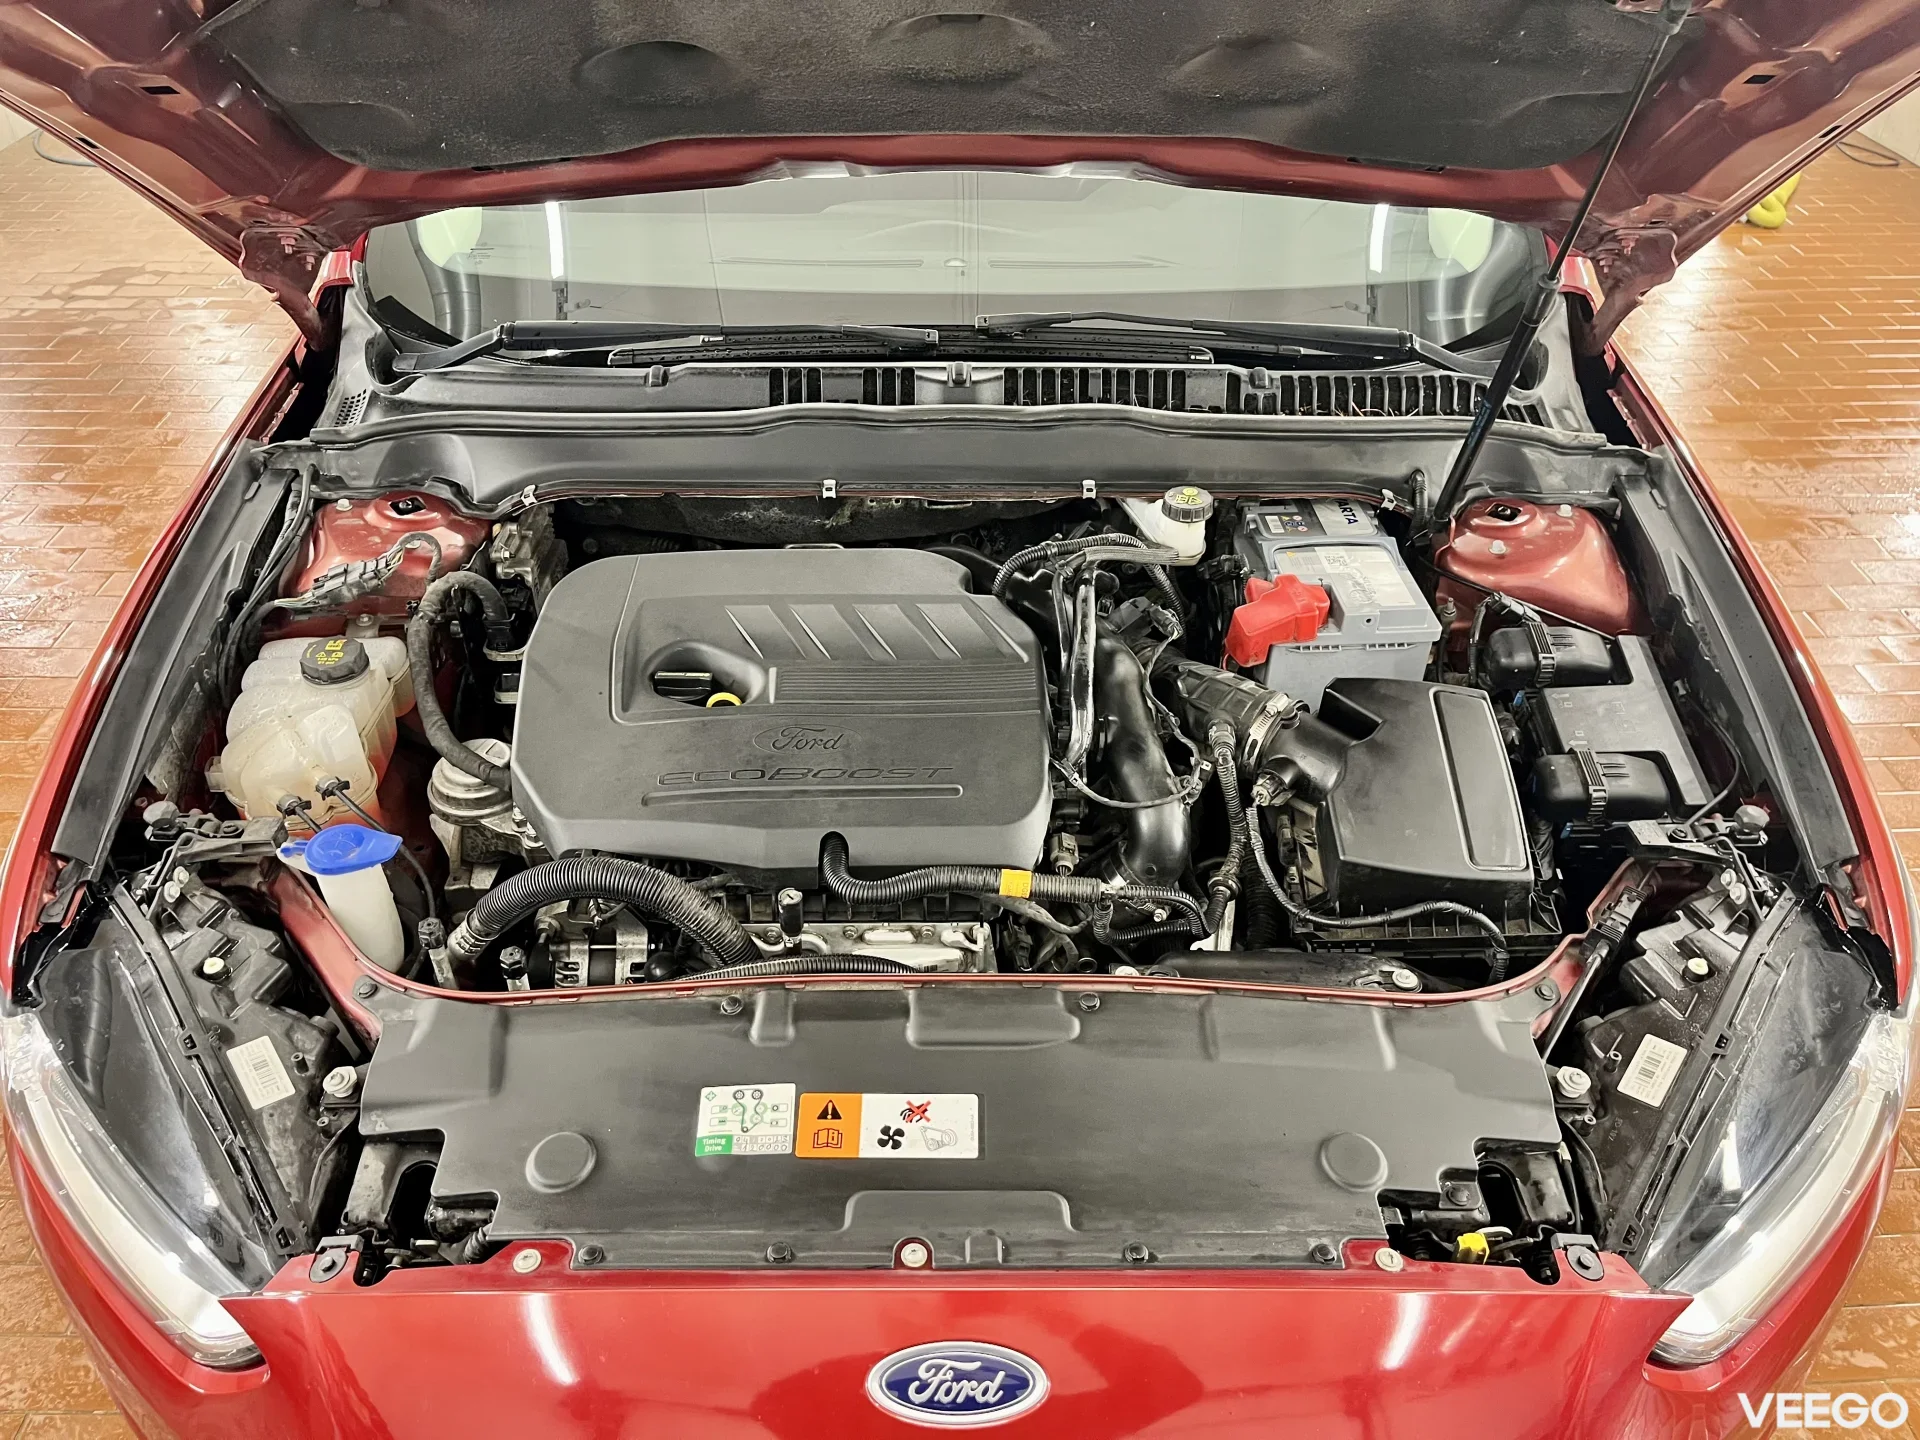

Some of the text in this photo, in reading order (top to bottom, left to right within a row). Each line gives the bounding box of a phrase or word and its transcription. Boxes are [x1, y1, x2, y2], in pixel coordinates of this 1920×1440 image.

[1336, 499, 1359, 525] ARTA
[771, 725, 845, 752] Ford
[702, 1138, 726, 1146] Timing
[907, 1358, 1006, 1405] Ford
